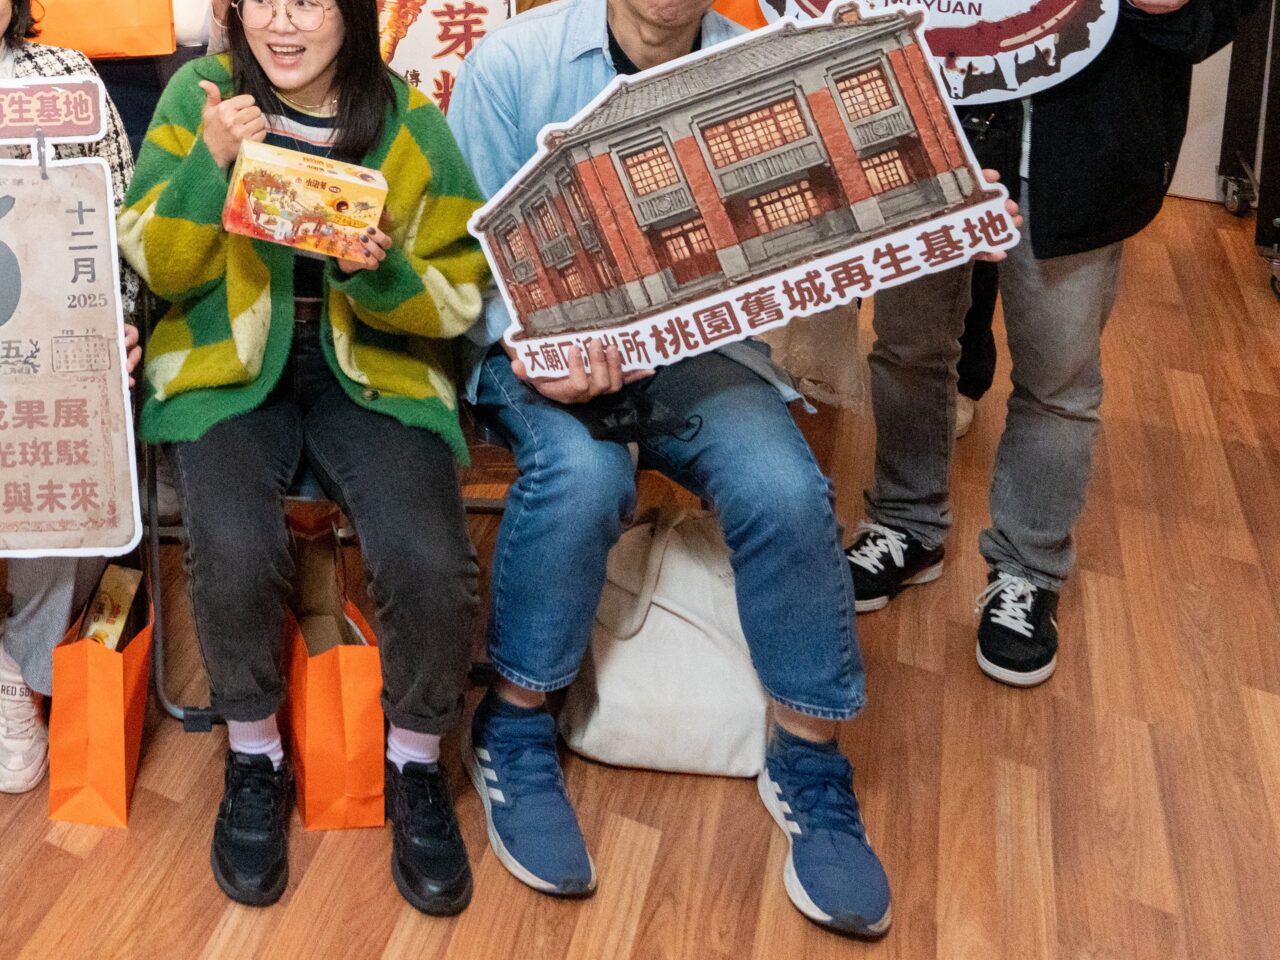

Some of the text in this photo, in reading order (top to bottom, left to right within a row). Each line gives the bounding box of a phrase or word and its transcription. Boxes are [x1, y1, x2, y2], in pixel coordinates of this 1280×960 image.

[65, 201, 98, 284] 十二月
[67, 293, 108, 310] 2025
[649, 209, 1014, 360] 桃園舊城再生基地
[1, 684, 17, 696] RED
